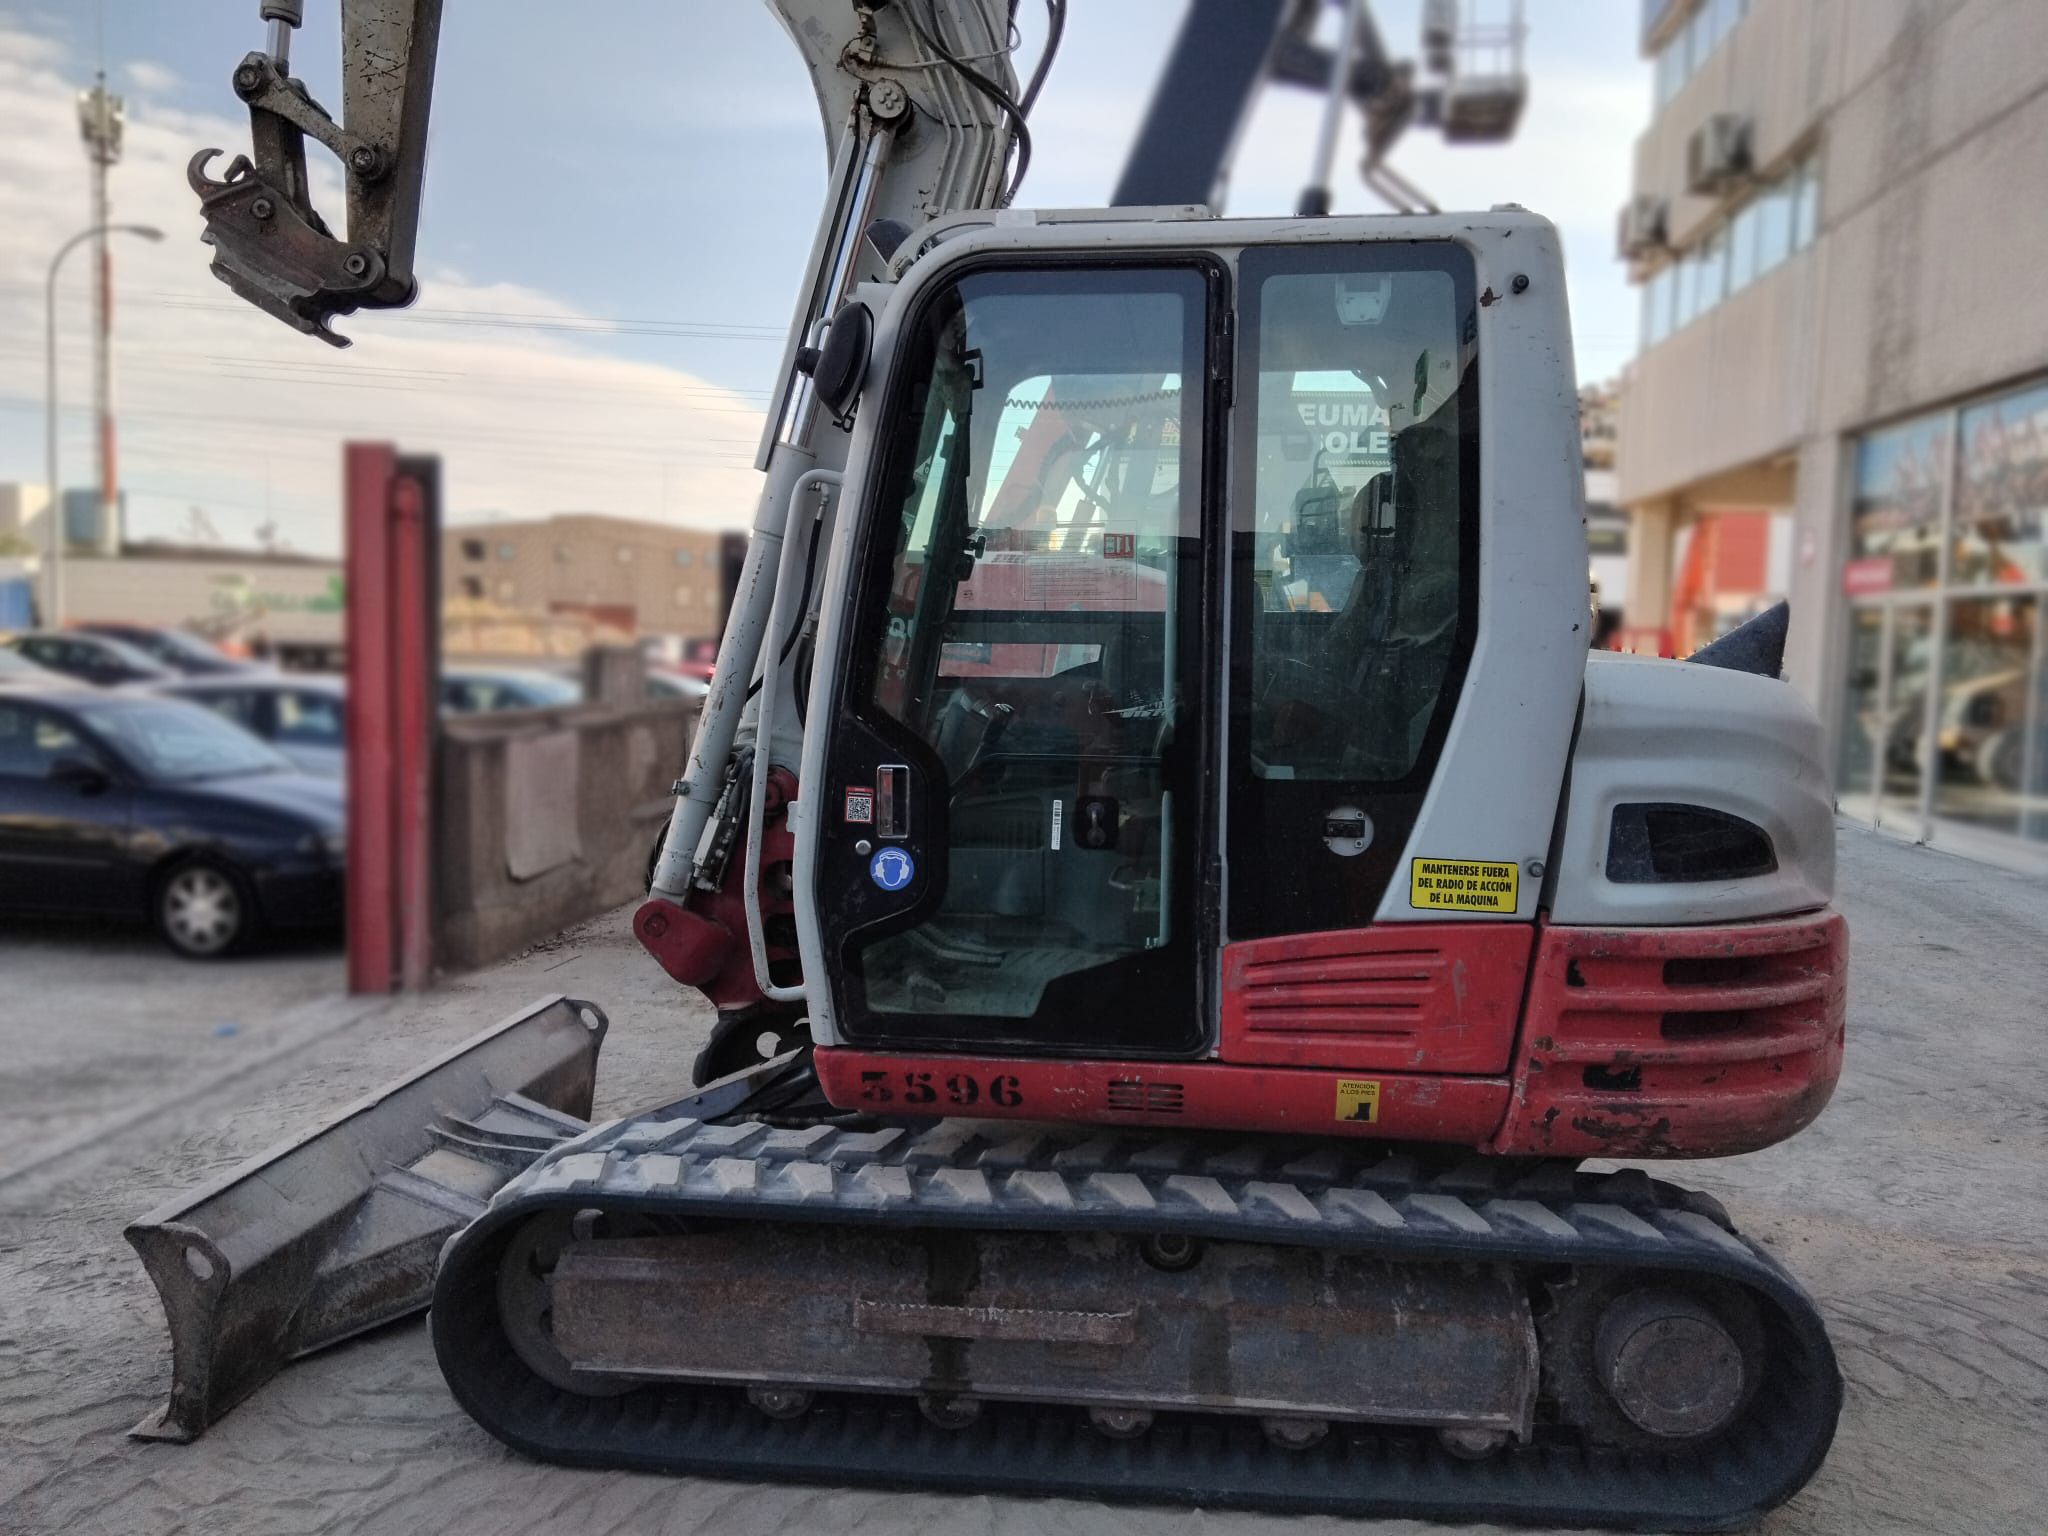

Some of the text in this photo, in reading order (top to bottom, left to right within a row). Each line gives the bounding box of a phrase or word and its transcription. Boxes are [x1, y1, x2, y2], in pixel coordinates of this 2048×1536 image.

[1422, 864, 1509, 878] MANTENERSE FUERA
[1418, 877, 1512, 893] DEL RADIO DE ACCIÓN
[1429, 891, 1498, 906] DE LA MÁQUINA
